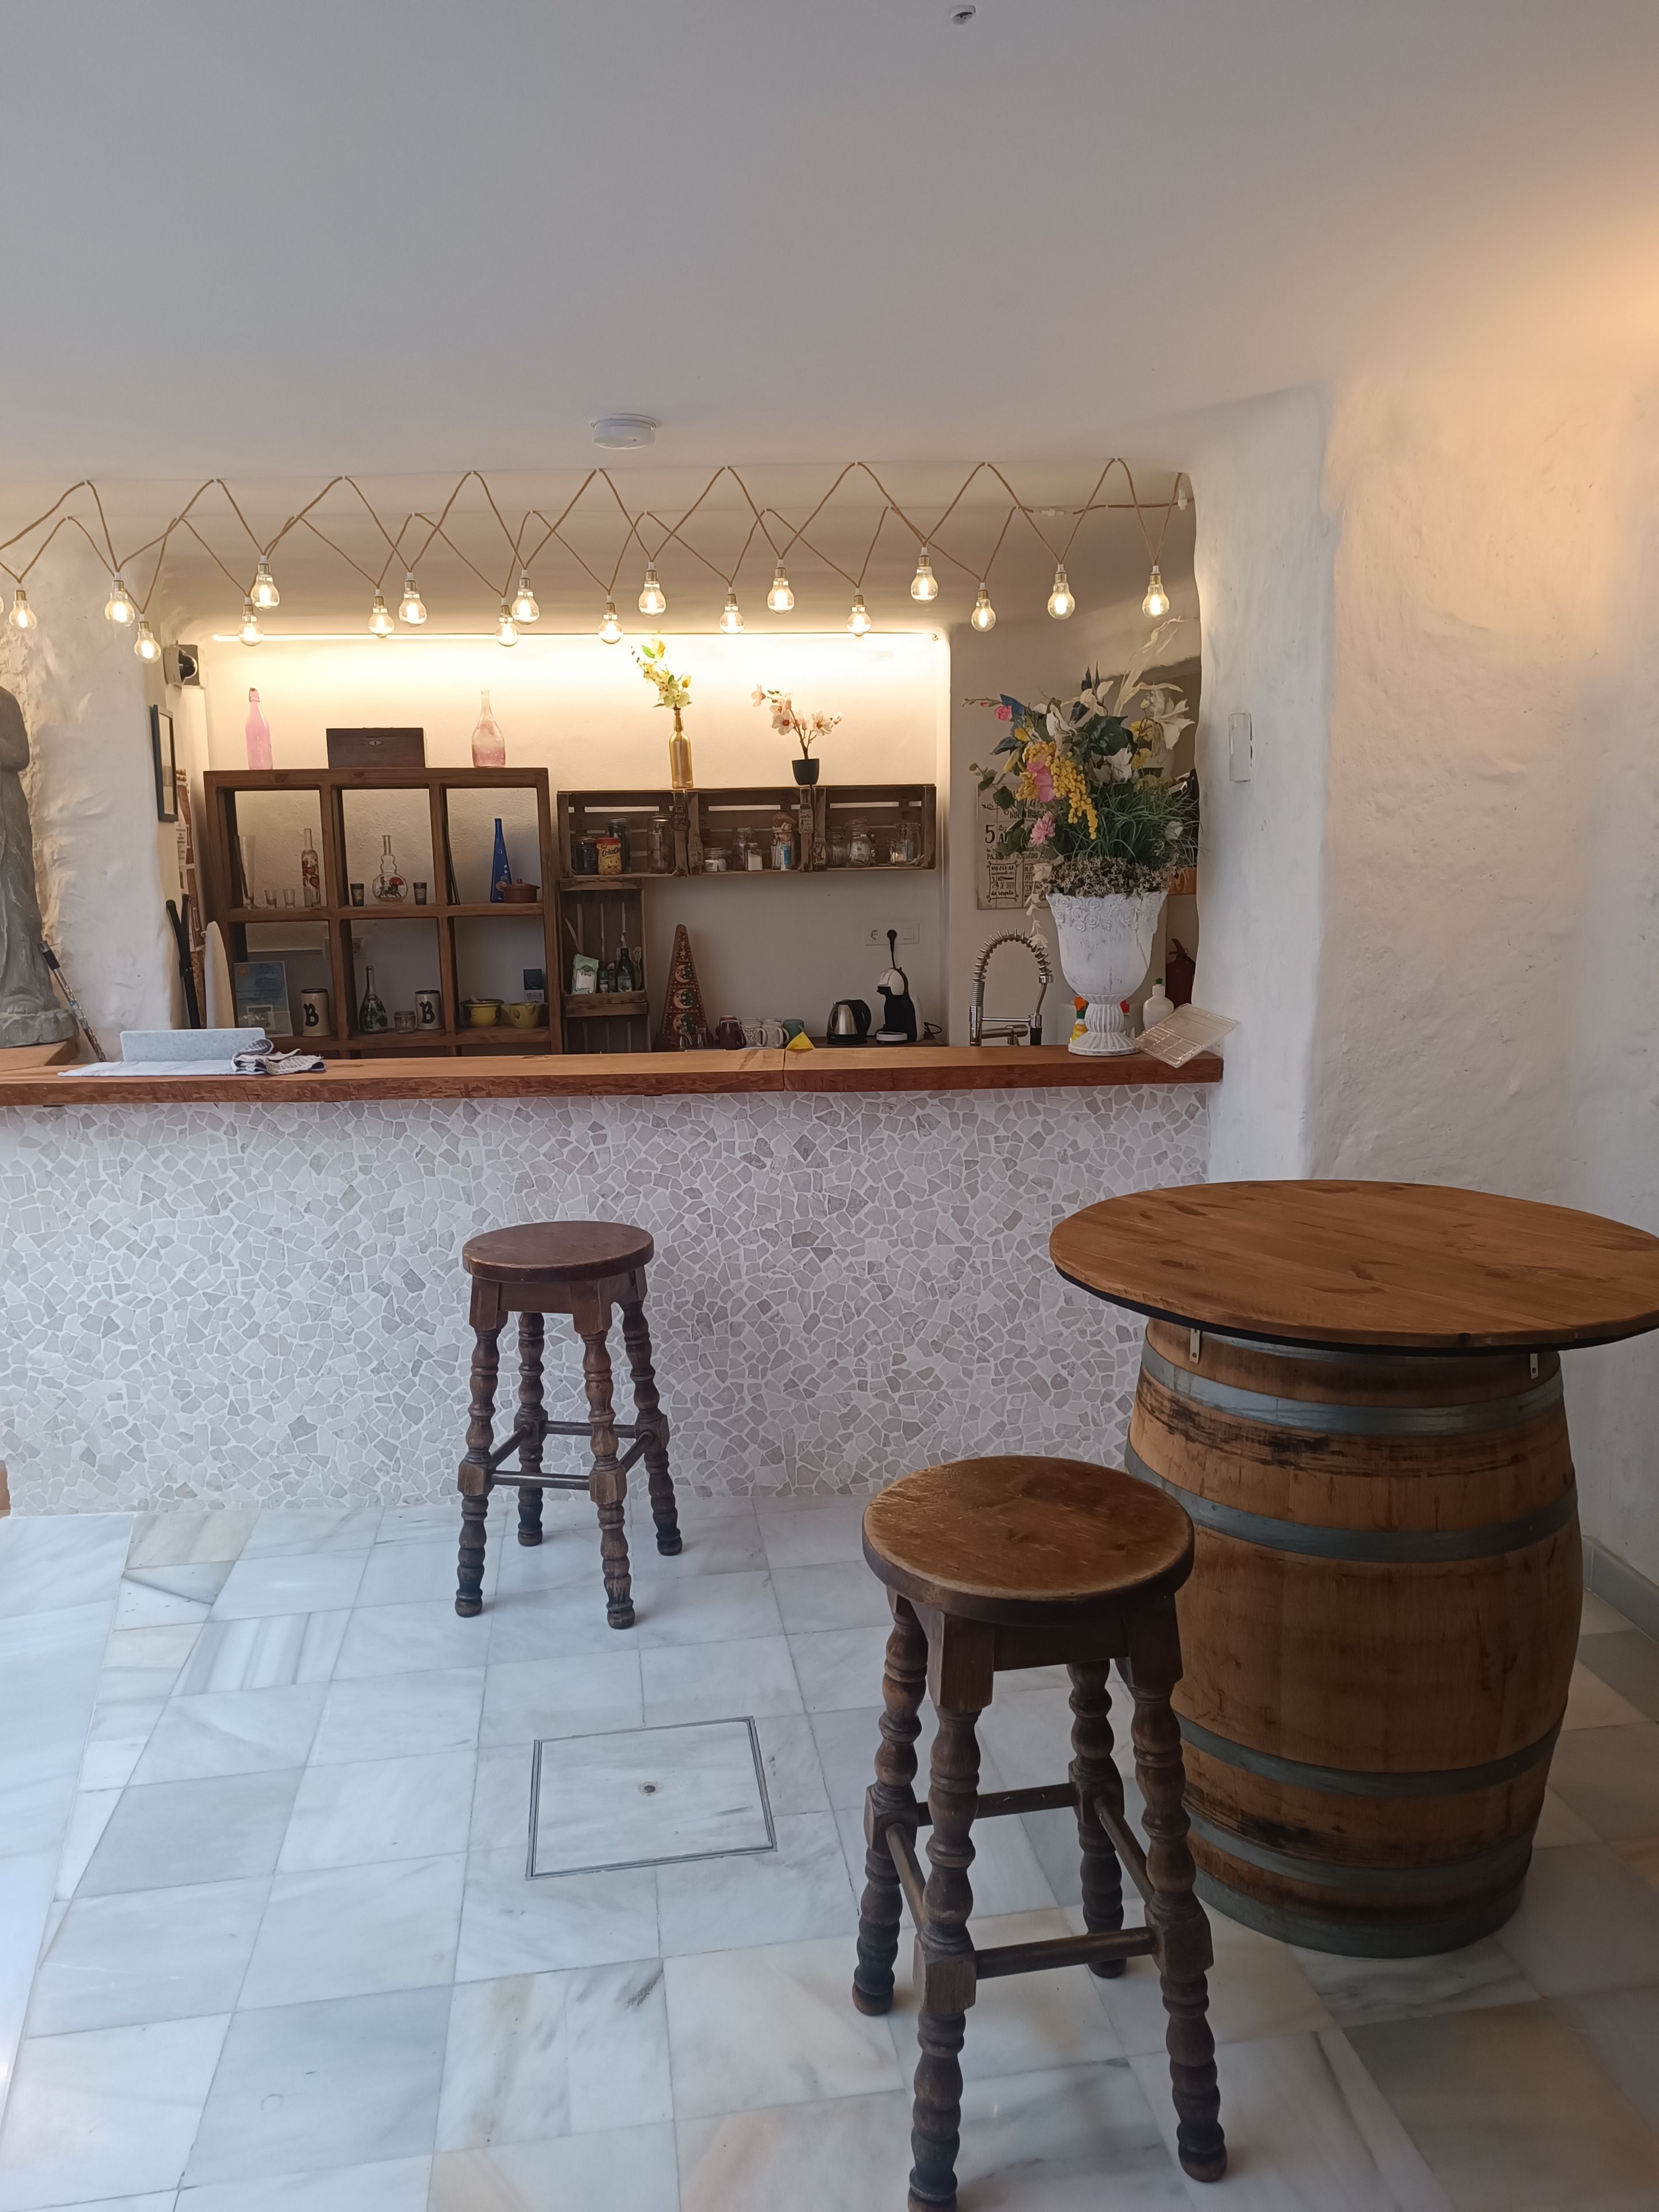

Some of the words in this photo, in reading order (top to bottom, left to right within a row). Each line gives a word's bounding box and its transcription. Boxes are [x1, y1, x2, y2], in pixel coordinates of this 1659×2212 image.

[985, 824, 995, 843] 5
[602, 847, 622, 857] ColaCa
[303, 1002, 319, 1027] B
[419, 1001, 435, 1024] B
